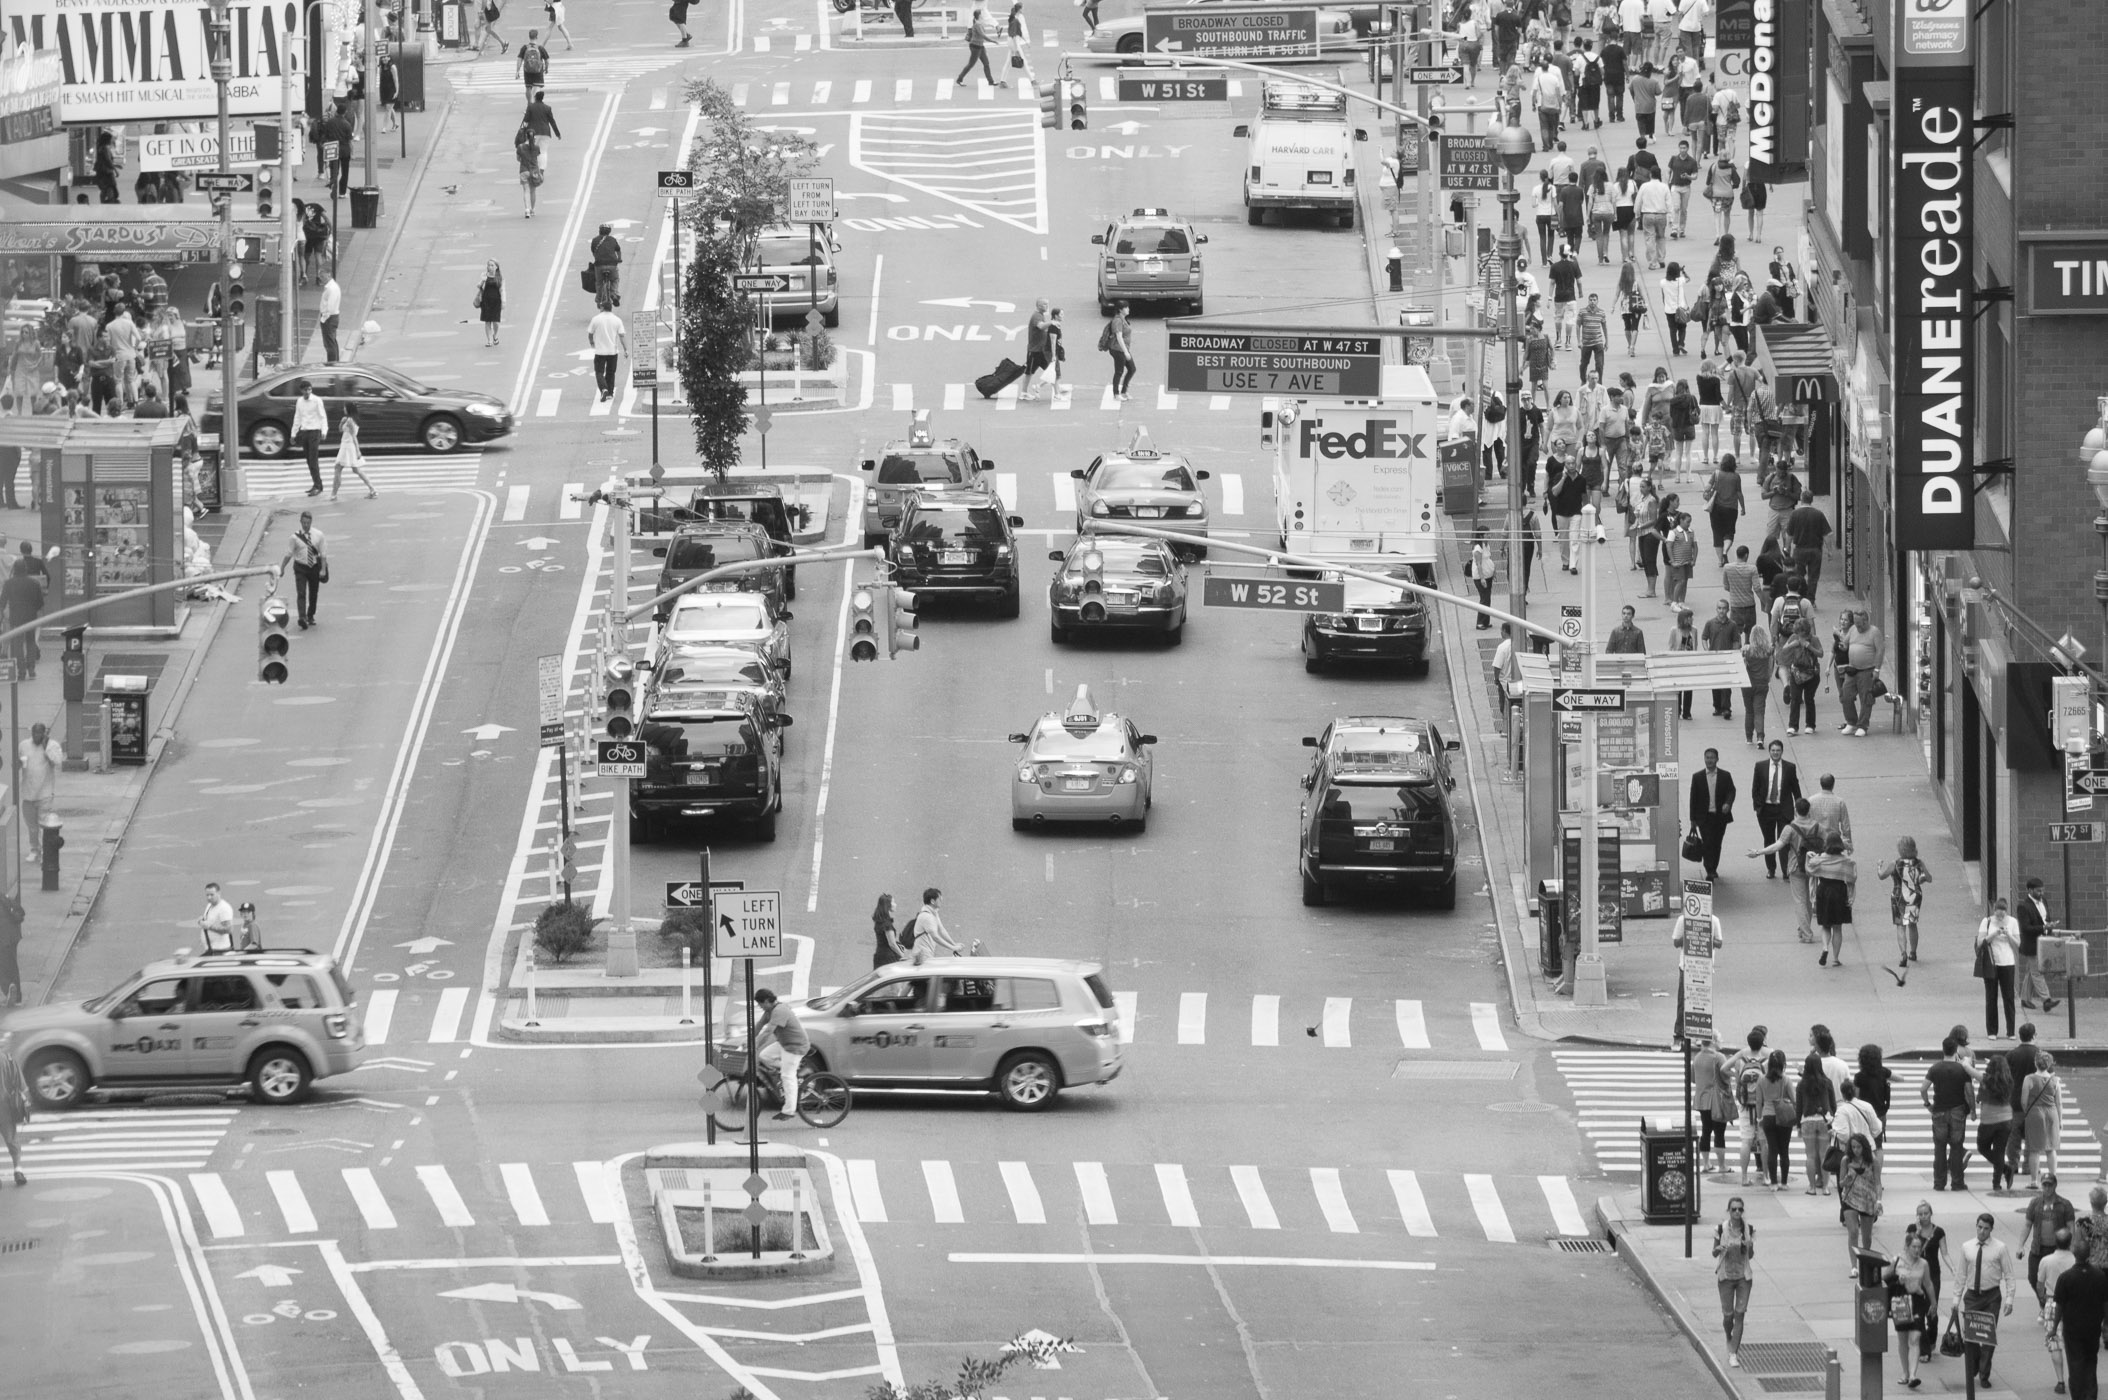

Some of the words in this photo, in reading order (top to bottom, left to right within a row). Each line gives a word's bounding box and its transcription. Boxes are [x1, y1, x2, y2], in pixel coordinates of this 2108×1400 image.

[1178, 17, 1237, 28] BROADWAY
[1242, 16, 1284, 27] CLOSED
[1912, 20, 1960, 32] Walgreens
[1196, 31, 1263, 43] SOUTHBOUND
[1268, 30, 1307, 41] TRAFFIC
[1912, 31, 1959, 41] pharmacy
[9, 10, 186, 84] MAMMA
[1915, 40, 1953, 49] network
[1440, 72, 1456, 80] WAY
[1141, 84, 1156, 98] W
[1162, 84, 1181, 98] 51
[1186, 84, 1206, 98] St
[75, 91, 114, 106] SMASH
[116, 90, 135, 104] HIT
[138, 88, 186, 104] MUSICAL
[146, 139, 174, 156] GET
[180, 138, 195, 155] IN
[229, 136, 256, 152] THE
[1271, 142, 1311, 154] HARVARD
[1312, 146, 1336, 155] CARE
[1447, 138, 1486, 149] BROADWA
[1066, 145, 1193, 159] ONLY
[1454, 151, 1486, 161] CLOSED
[172, 158, 196, 167] GREAT
[196, 156, 219, 166] SEATS
[1447, 164, 1457, 174] AT
[1459, 164, 1466, 173] W
[1469, 164, 1480, 173] 47
[1482, 164, 1493, 174] ST
[228, 178, 245, 187] WAY
[793, 183, 810, 191] LEFT
[812, 182, 830, 190] TURN
[1447, 177, 1464, 187] USE
[1468, 177, 1473, 187] 7
[1477, 177, 1492, 187] AVE
[660, 188, 673, 196] BIKE
[676, 188, 692, 196] PATH
[802, 191, 821, 199] FROM
[812, 200, 830, 208] TURN
[811, 209, 829, 217] ONLY
[842, 214, 985, 232] ONLY
[66, 225, 168, 251] STARDUST
[181, 251, 190, 262] W
[742, 280, 758, 288] ONE
[764, 279, 782, 288] WAY
[887, 324, 1030, 341] ONLY
[1180, 337, 1245, 350] BROADWAY
[1252, 338, 1297, 350] CLOSED
[1303, 340, 1318, 351] AT
[1323, 341, 1333, 352] W
[1336, 341, 1351, 352] 47
[1354, 341, 1369, 353] ST
[1196, 355, 1226, 368] BEST
[1230, 356, 1268, 369] ROUTE
[1272, 357, 1351, 370] SOUTHBOUND
[1222, 372, 1258, 389] USE
[1267, 373, 1279, 389] 7
[1288, 374, 1324, 391] AVE
[1300, 418, 1428, 460] FedEx
[1373, 465, 1408, 476] Express
[1446, 463, 1470, 472] VOICE
[1231, 583, 1249, 602] W
[1257, 585, 1287, 605] 52
[1294, 586, 1319, 606] St
[71, 638, 80, 650] P
[1563, 695, 1584, 705] ONE
[1593, 695, 1616, 705] WAY
[1664, 706, 1673, 756] Newsstand
[601, 765, 618, 774] BIKE
[622, 764, 643, 773] PATH
[2084, 778, 2107, 788] ONE
[2051, 826, 2061, 841] W
[2064, 825, 2077, 841] 52
[2080, 825, 2089, 834] ST
[682, 889, 702, 899] ONE
[743, 900, 774, 913] LEFT
[742, 918, 775, 931] TURN
[743, 936, 776, 949] LANE
[1692, 1015, 1700, 1023] Pay
[1969, 1321, 1992, 1332] ANYTIME
[434, 1334, 652, 1378] ONLY
